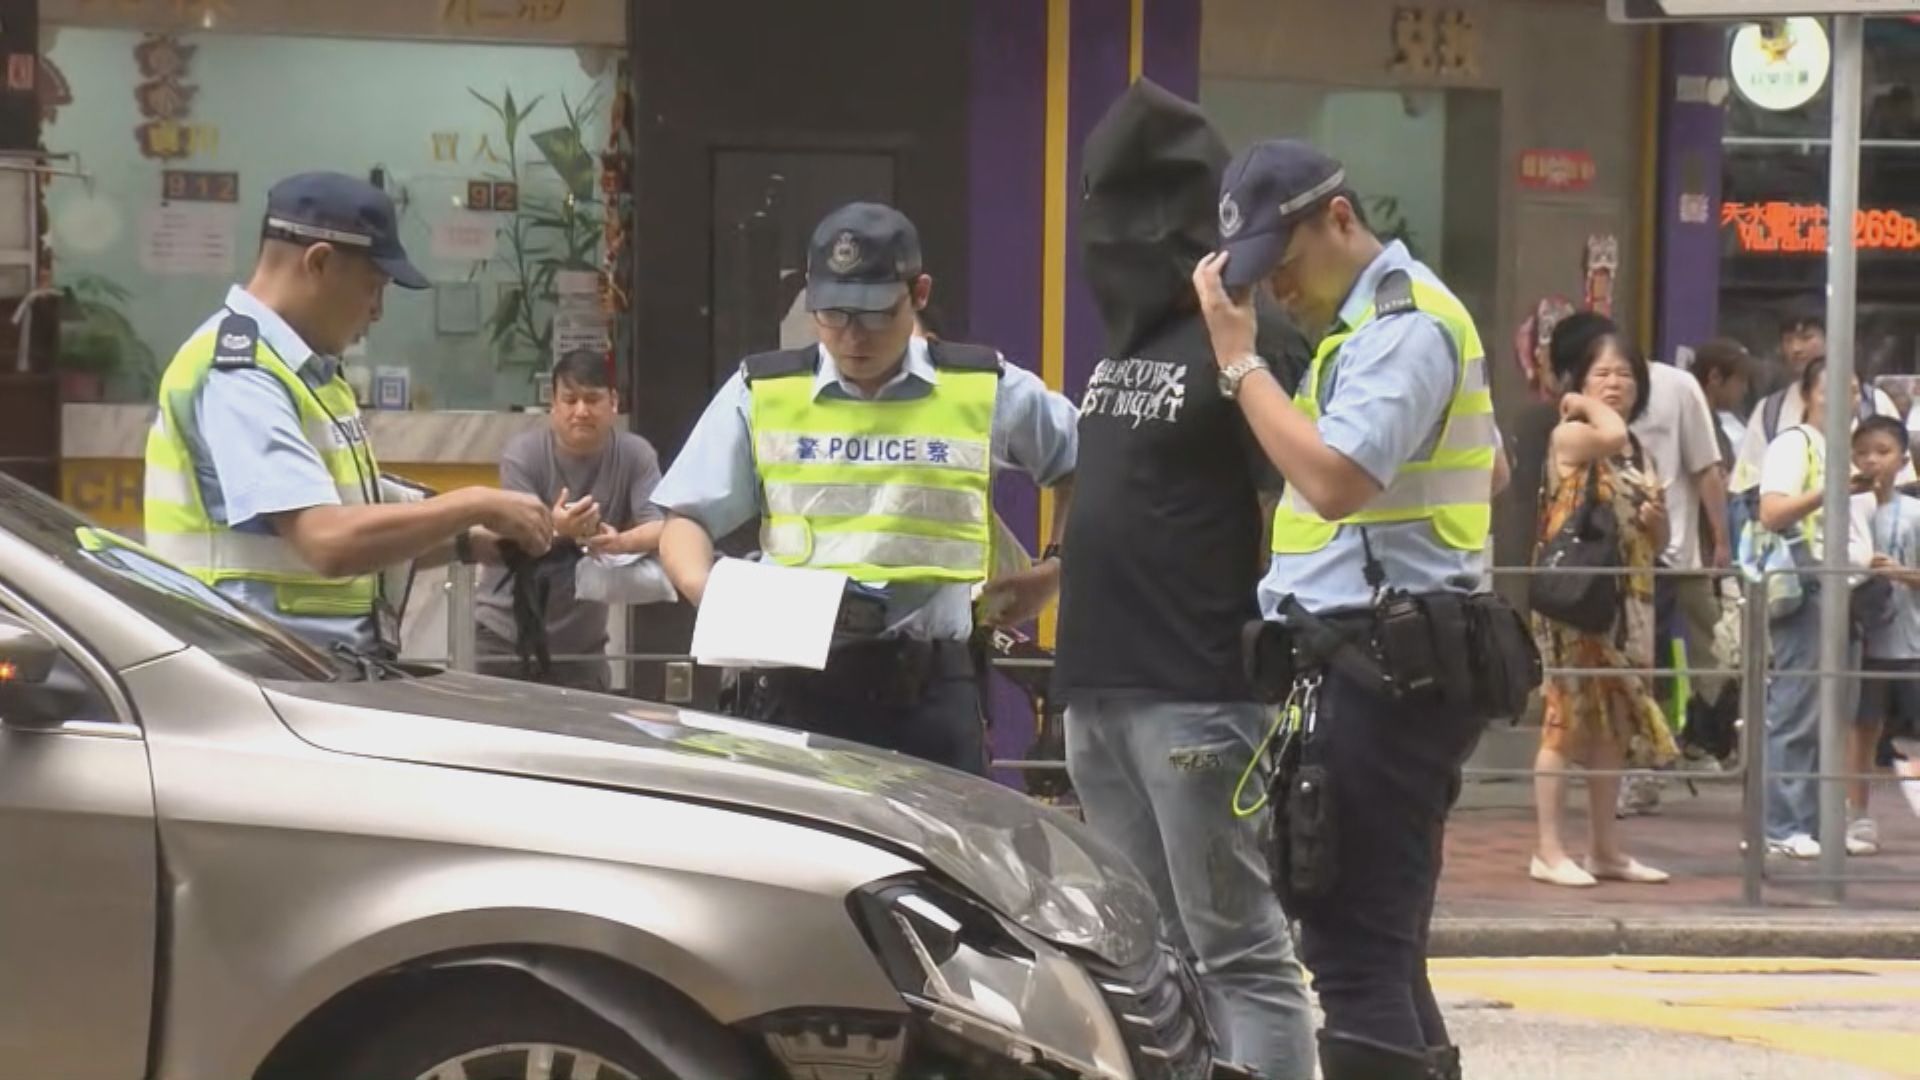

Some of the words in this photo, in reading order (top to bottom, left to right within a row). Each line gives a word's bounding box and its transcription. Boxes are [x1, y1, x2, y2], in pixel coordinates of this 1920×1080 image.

[797, 437, 818, 460] 警
[829, 437, 917, 462] POLICE
[927, 440, 949, 463] 察
[73, 473, 144, 511] CH
